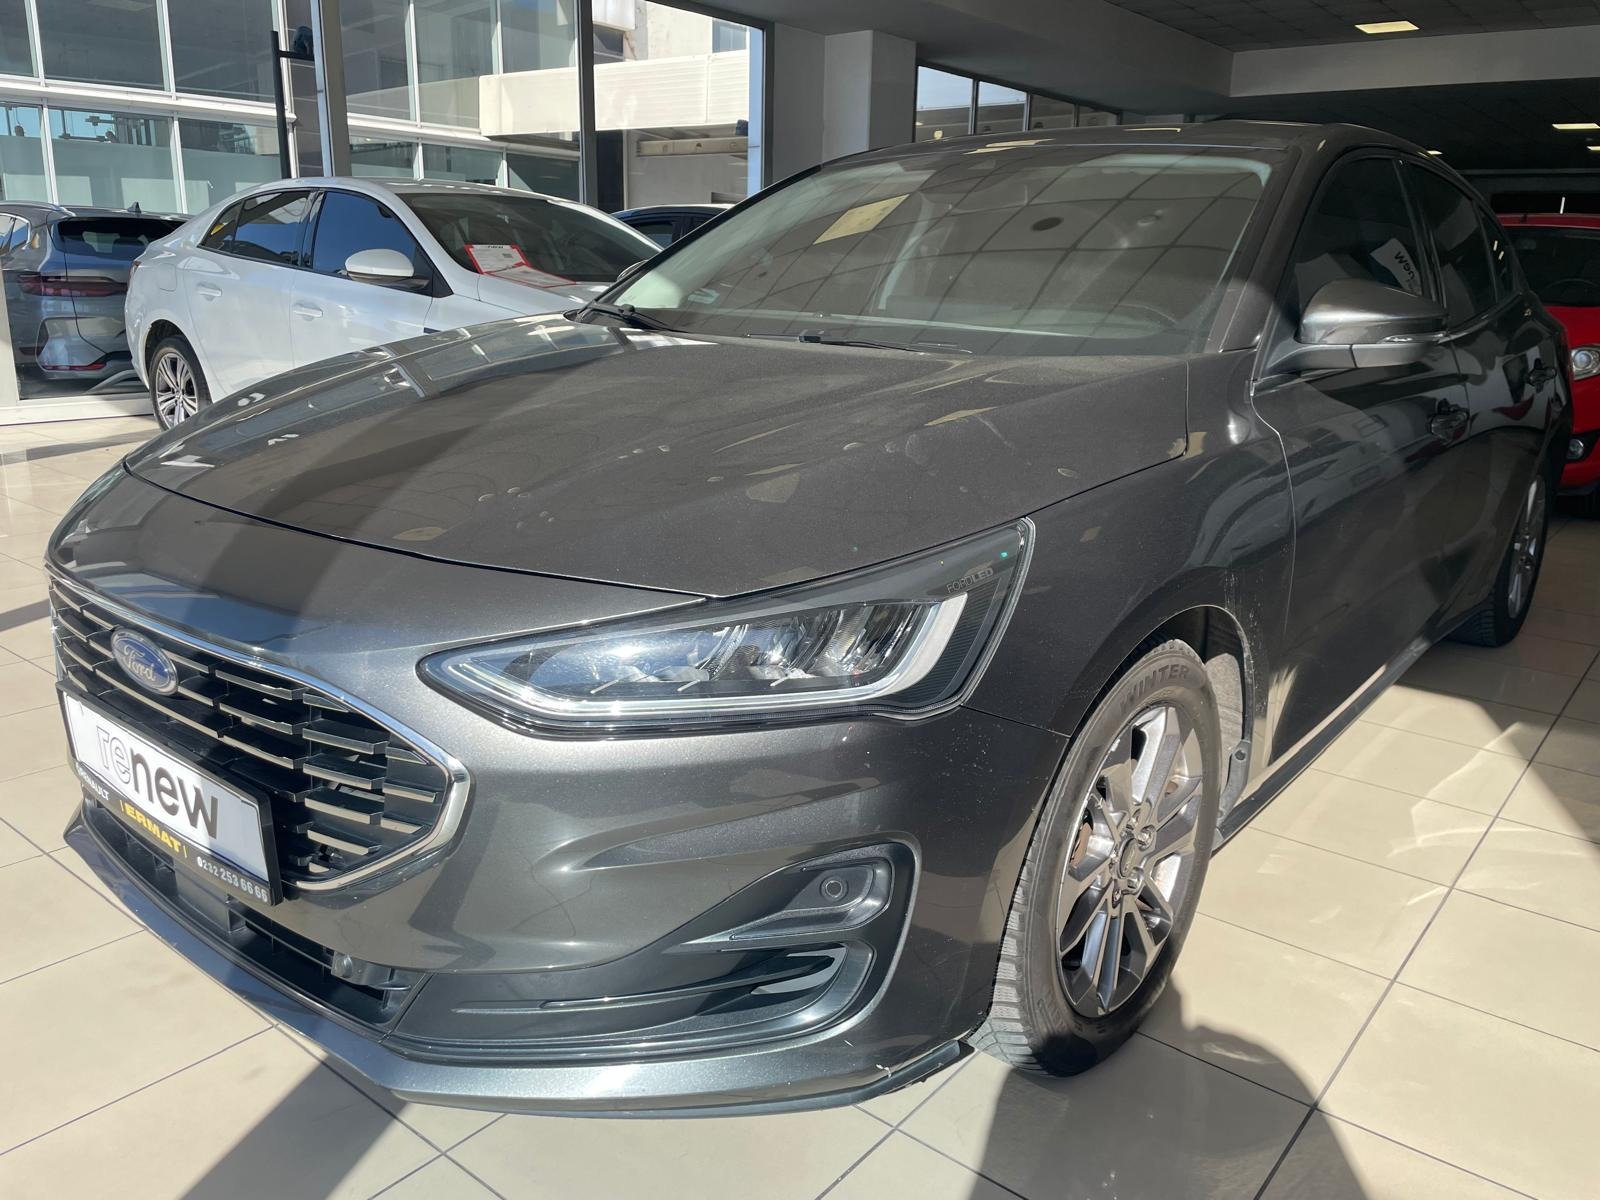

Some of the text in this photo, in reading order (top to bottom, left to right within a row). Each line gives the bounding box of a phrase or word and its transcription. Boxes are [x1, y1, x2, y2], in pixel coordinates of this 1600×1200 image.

[123, 644, 157, 683] Ford
[96, 724, 219, 840] renew
[125, 801, 183, 853] ERMAT
